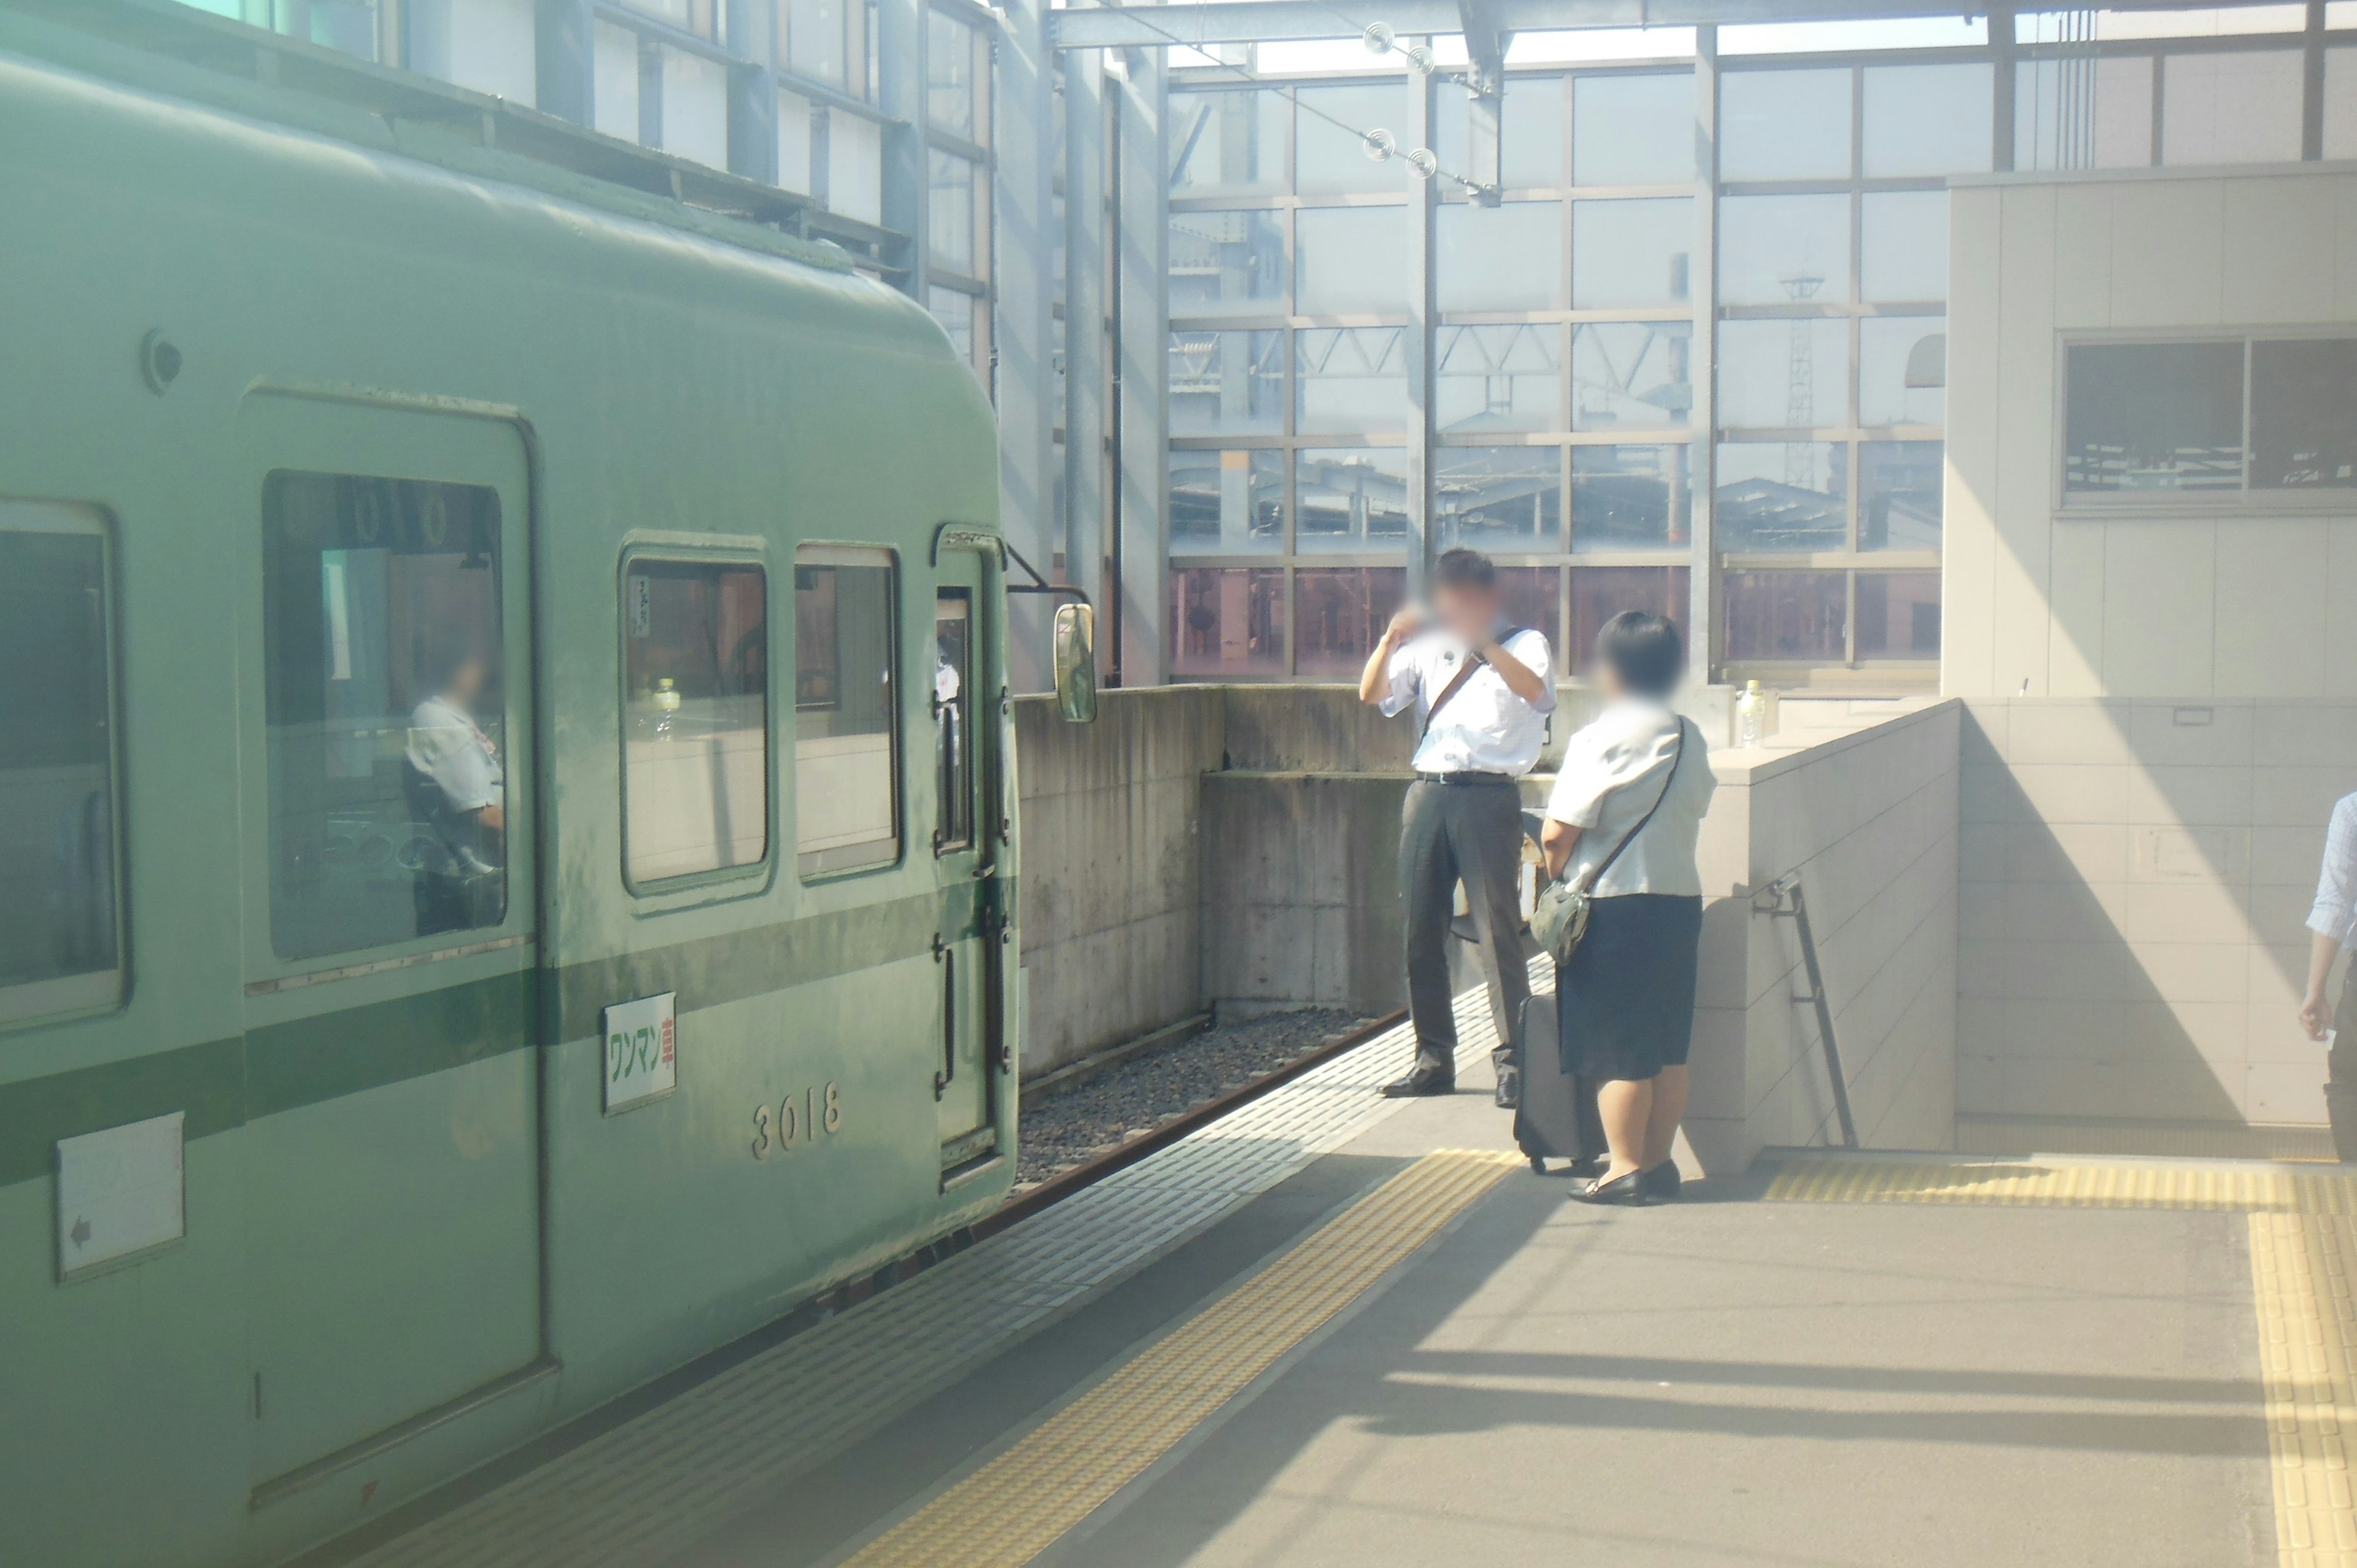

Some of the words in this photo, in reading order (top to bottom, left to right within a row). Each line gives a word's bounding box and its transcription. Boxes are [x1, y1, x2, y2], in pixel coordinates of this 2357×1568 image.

[610, 1018, 673, 1083] ワンマン車
[752, 1081, 841, 1160] 3018
